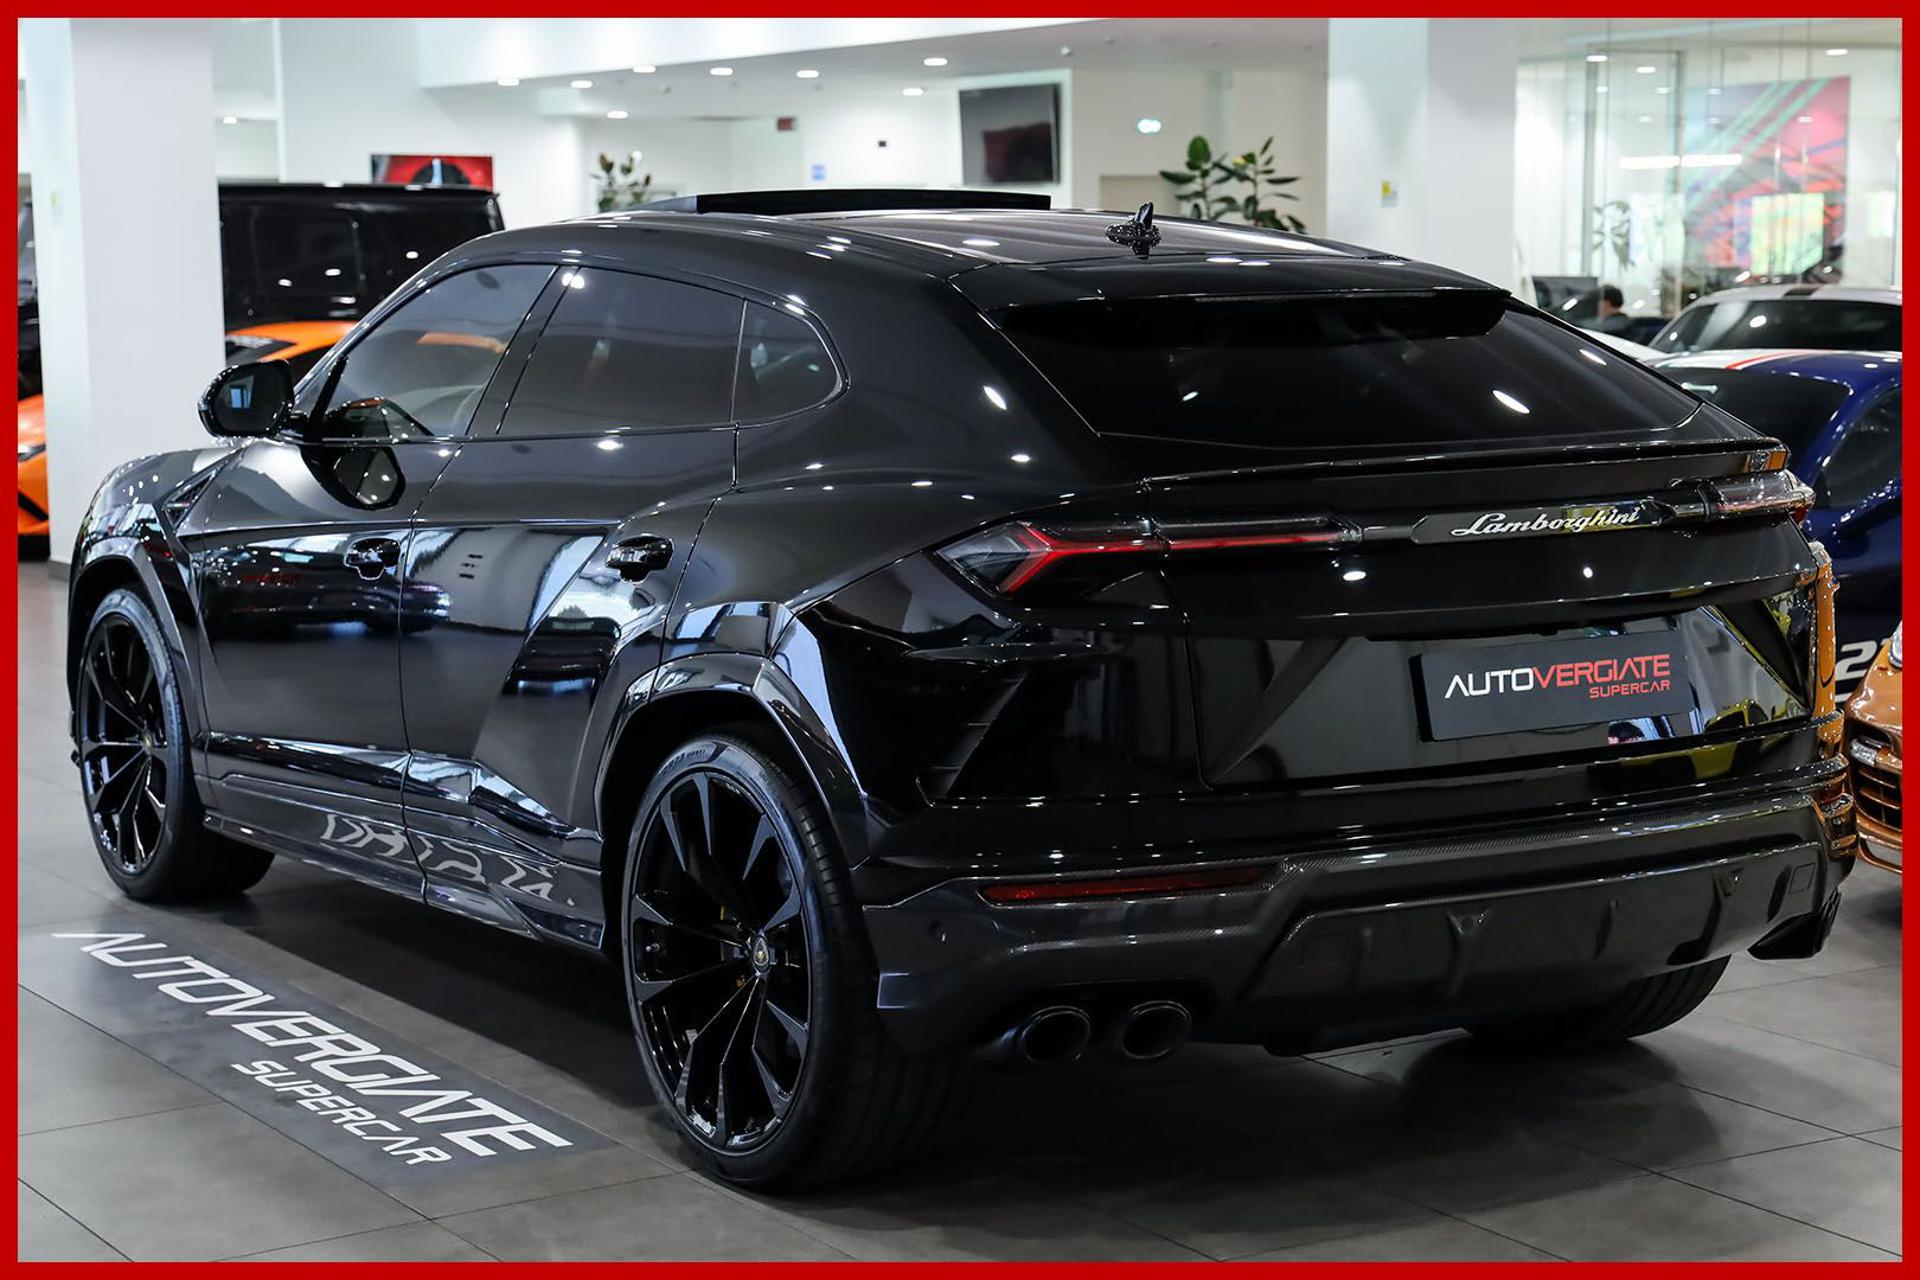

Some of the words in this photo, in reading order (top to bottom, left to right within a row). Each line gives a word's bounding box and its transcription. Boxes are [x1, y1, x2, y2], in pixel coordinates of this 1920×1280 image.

[1450, 503, 1643, 536] Lamborghini
[1444, 653, 1671, 699] AUTOVERGIATE
[1589, 679, 1671, 700] SUPERCAR
[51, 932, 574, 1157] AUTOVERGIATE
[230, 1059, 453, 1166] SUPERCAR
